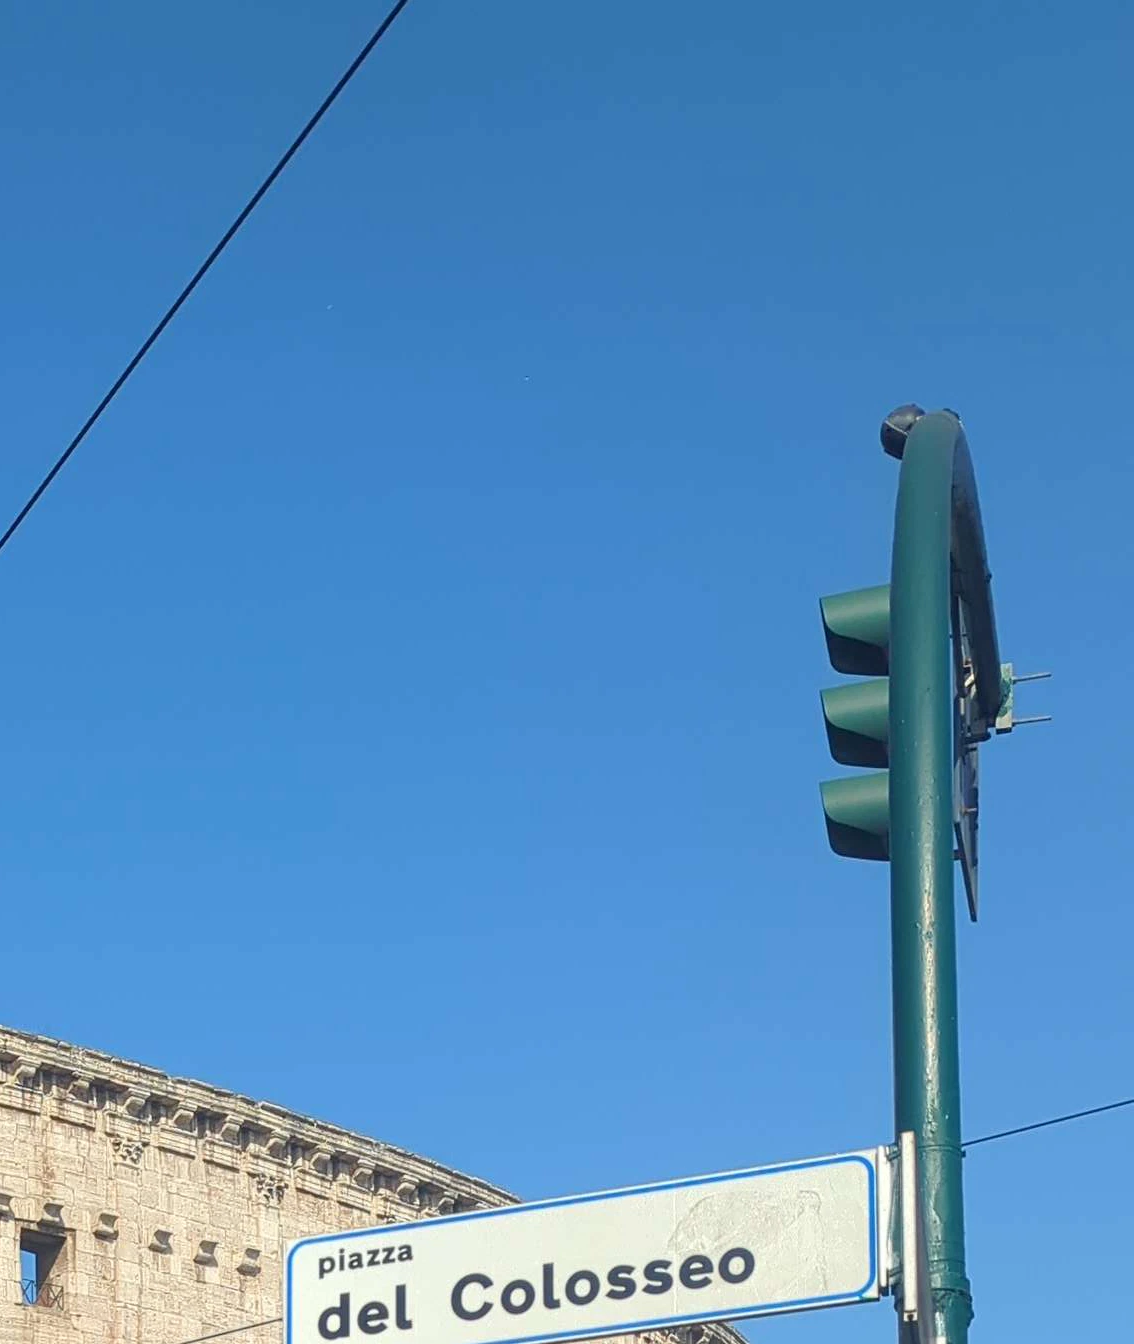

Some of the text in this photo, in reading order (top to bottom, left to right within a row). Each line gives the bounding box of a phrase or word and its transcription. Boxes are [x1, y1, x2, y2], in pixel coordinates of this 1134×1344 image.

[318, 1245, 414, 1279] piazza
[318, 1247, 755, 1340] del Colosseo
